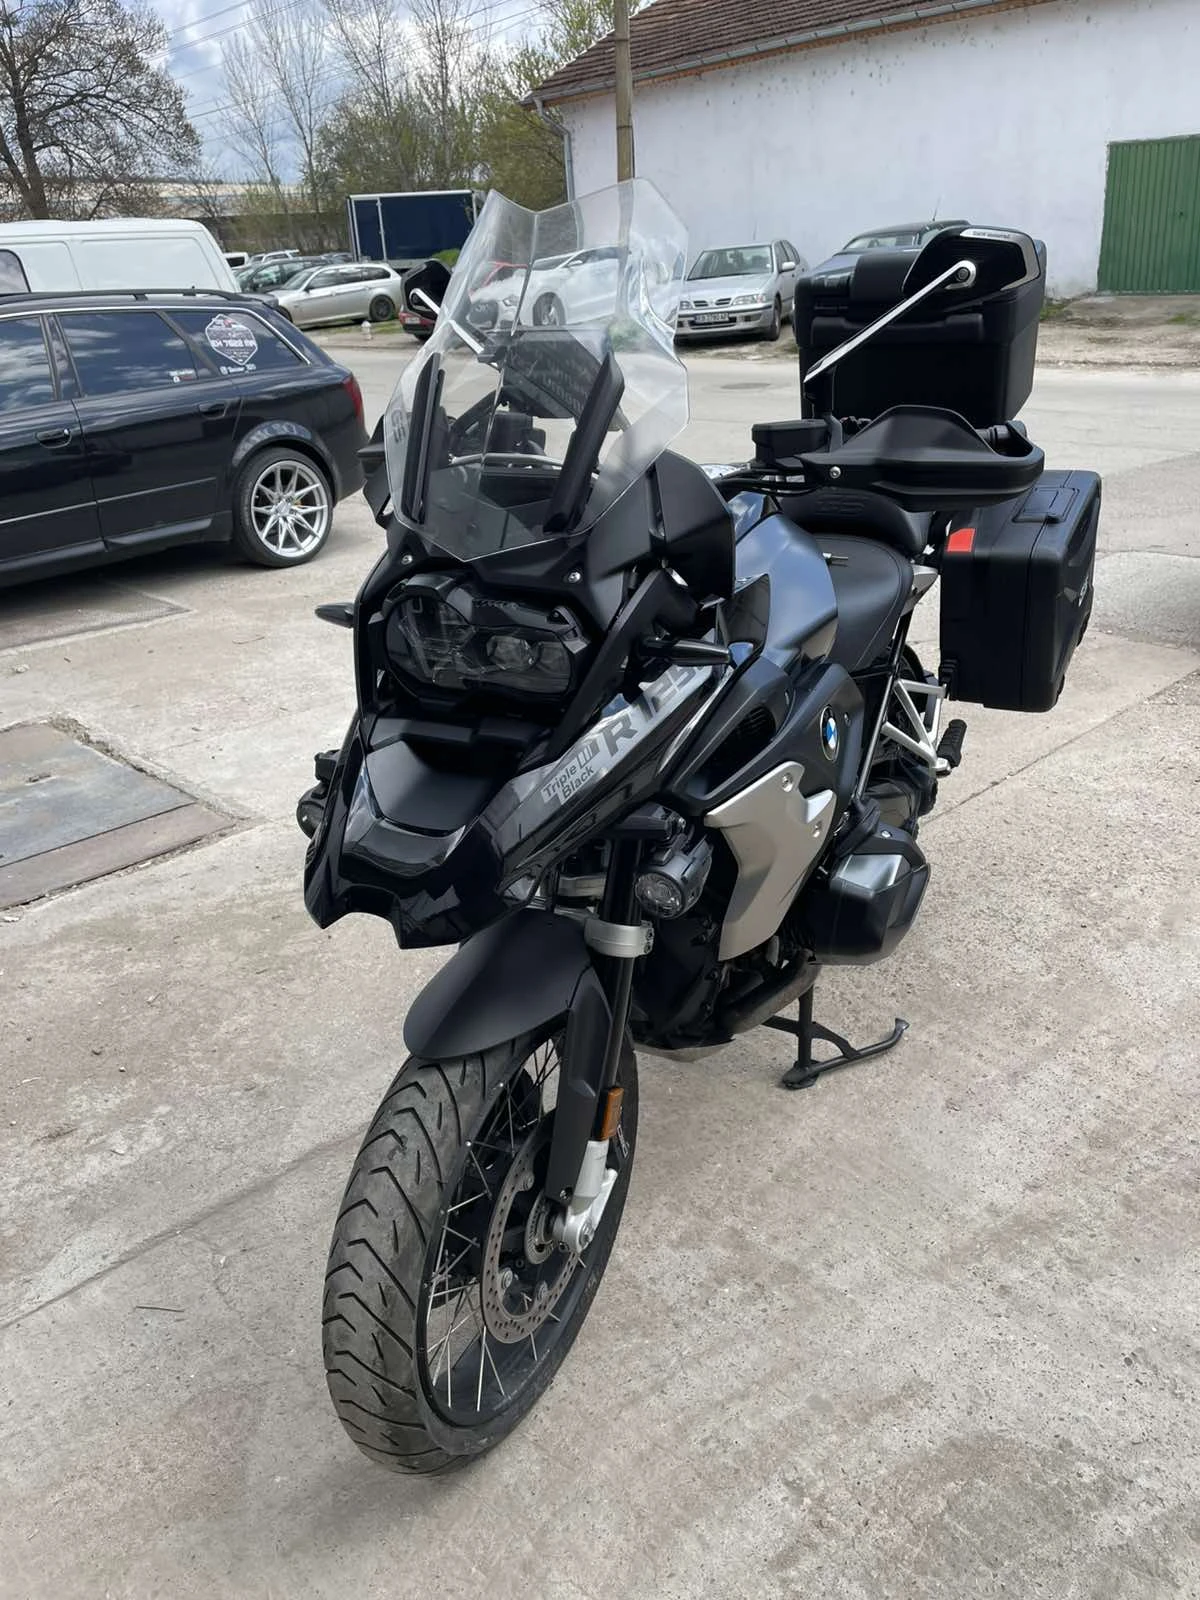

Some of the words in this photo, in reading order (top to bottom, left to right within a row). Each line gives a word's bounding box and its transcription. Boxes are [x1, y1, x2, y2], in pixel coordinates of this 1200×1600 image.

[632, 665, 705, 722] 125
[543, 765, 577, 797] Triple
[561, 766, 594, 799] Black
